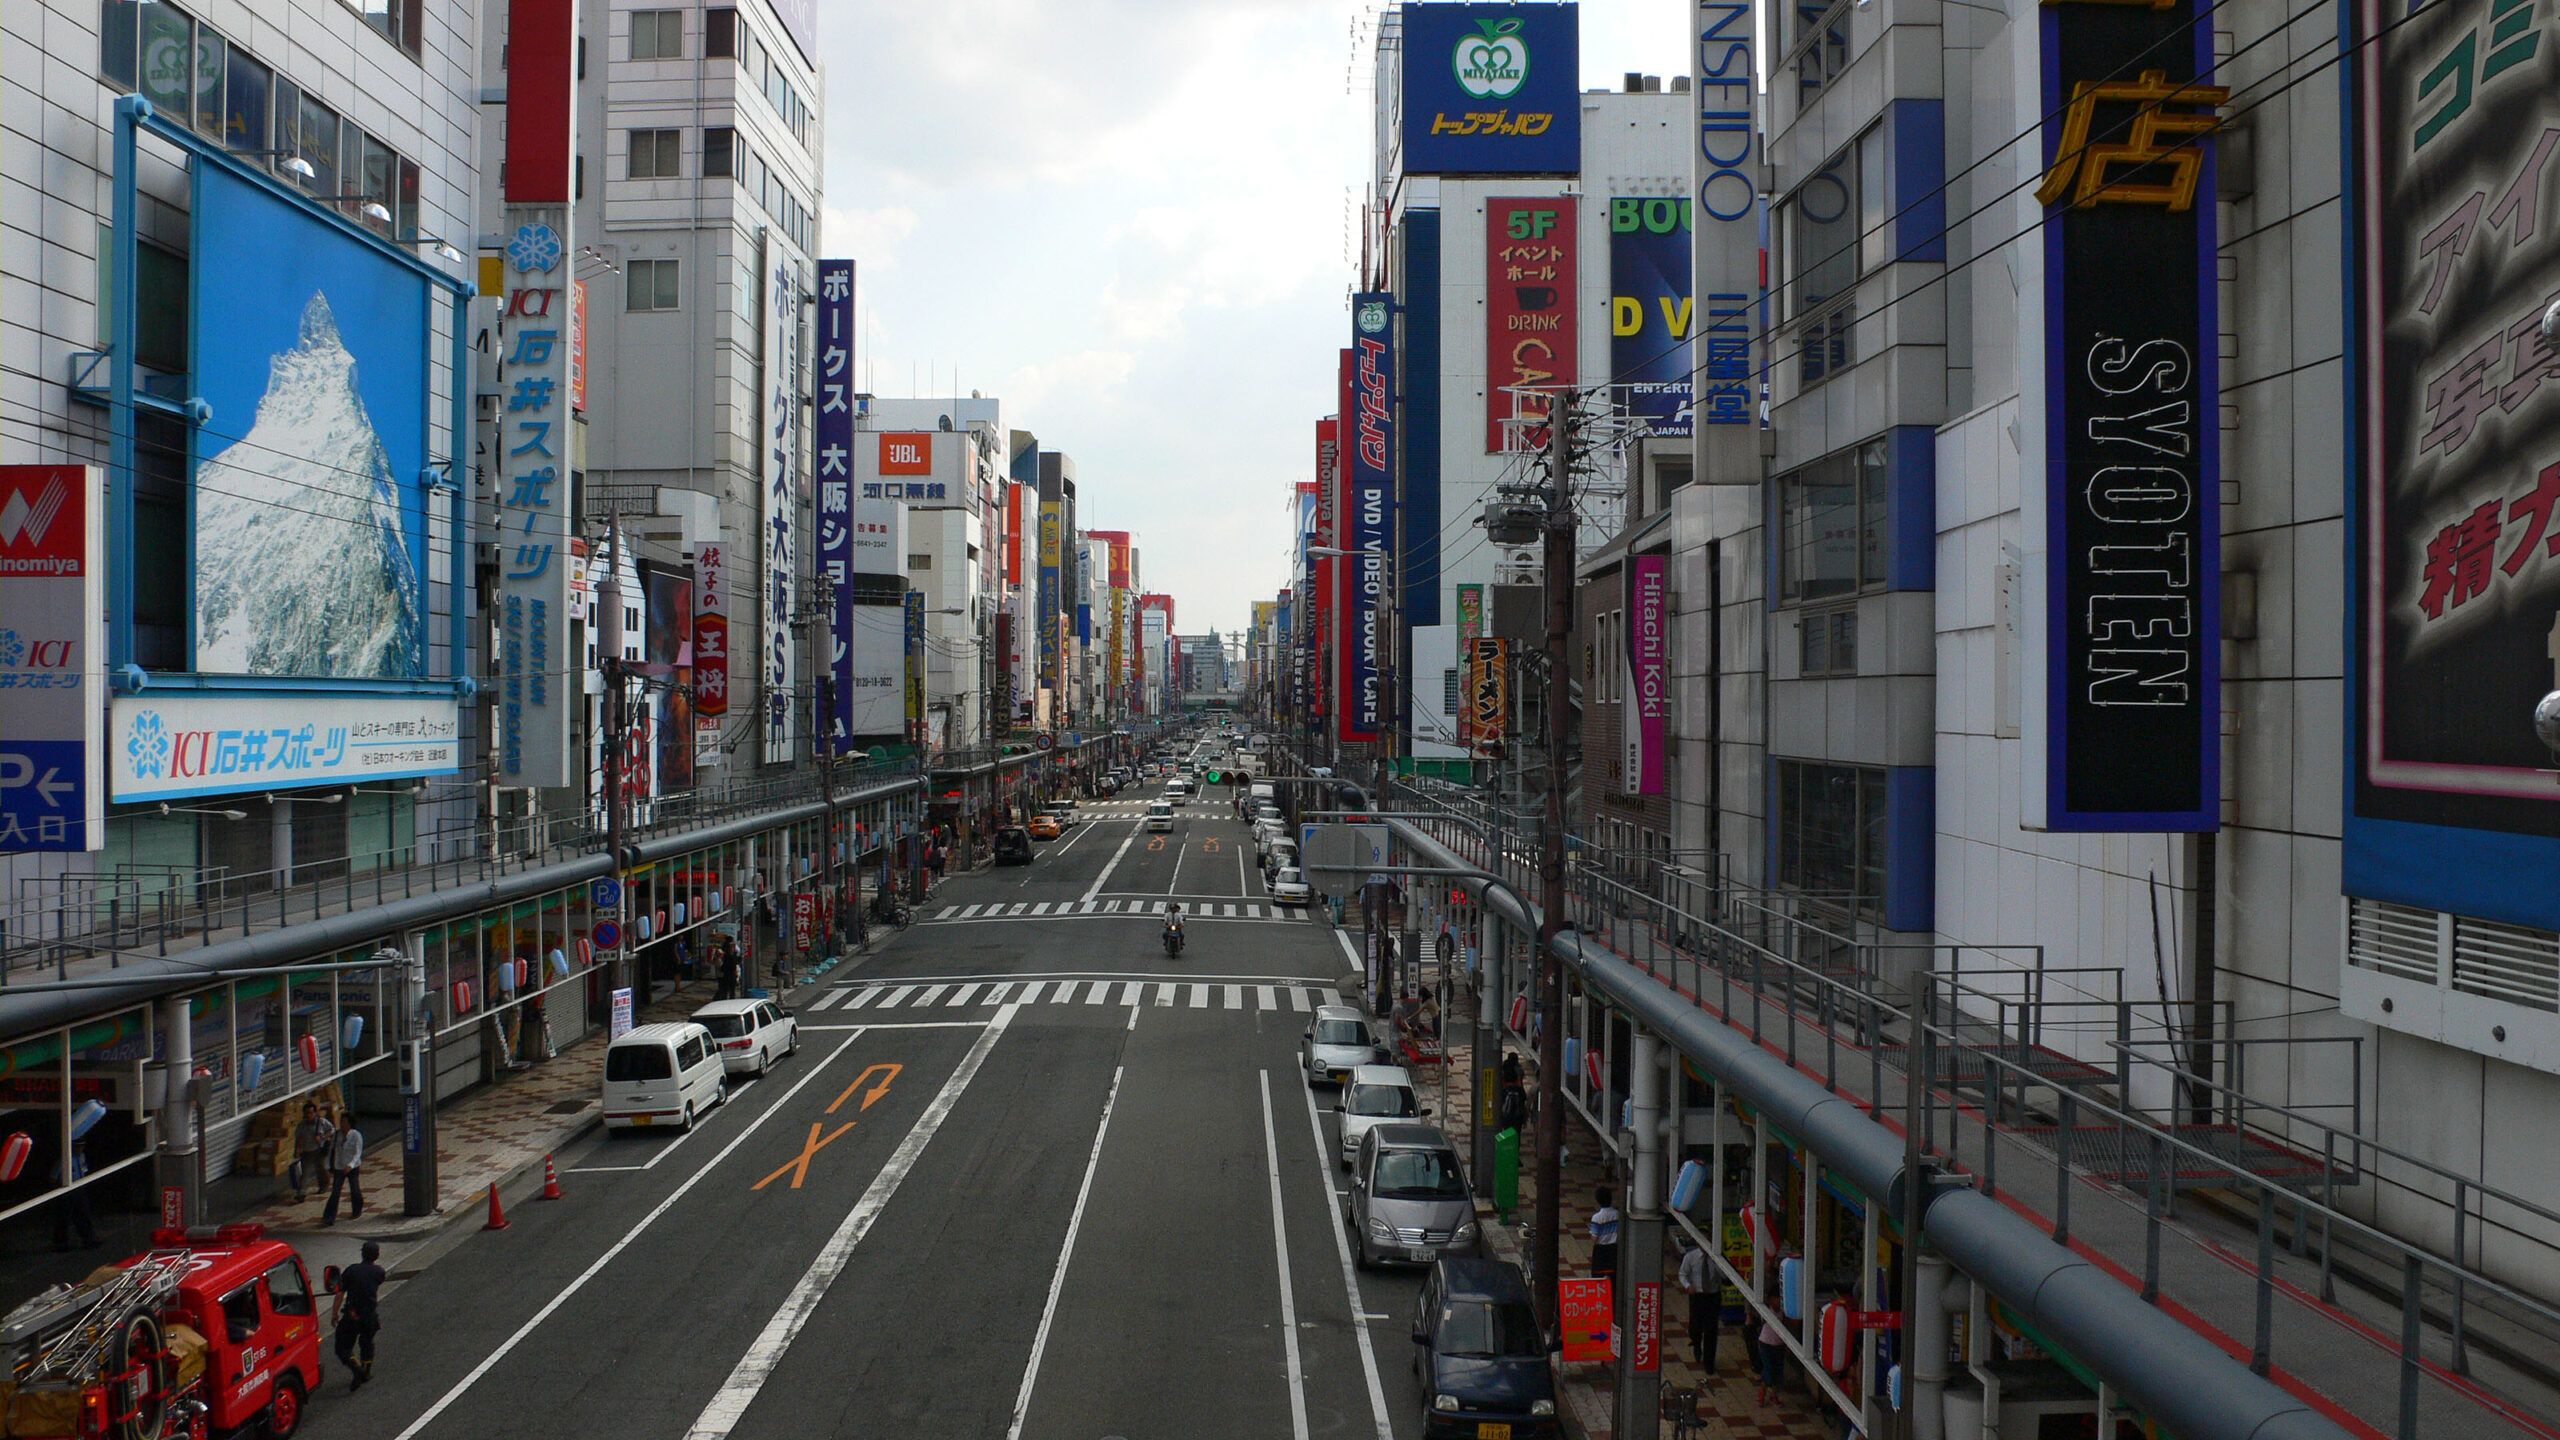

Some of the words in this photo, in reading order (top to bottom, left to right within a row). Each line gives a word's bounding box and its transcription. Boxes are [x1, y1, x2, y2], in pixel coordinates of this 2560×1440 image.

[1463, 68, 1520, 83] MIYATAKE
[1430, 109, 1554, 136] トップジャパン
[1507, 210, 1556, 240] 5F
[1499, 245, 1563, 262] イベント
[1507, 265, 1557, 282] ホール
[506, 288, 556, 318] ICI
[1508, 314, 1562, 331] DRINK
[822, 269, 849, 415] ボークス
[1359, 336, 1391, 472] トップジャパン
[506, 330, 560, 580] 石井スポーツ
[890, 444, 921, 463] JBL
[863, 482, 945, 499] 河口無線
[1321, 440, 1335, 521] Ninomiya
[1364, 488, 1381, 525] DVD
[2087, 336, 2191, 705] SYOTEN
[699, 547, 721, 607] 餃子の
[1643, 573, 1660, 657] Hitachi
[28, 640, 76, 668] ICI
[530, 599, 545, 706] MOUNTAIN
[696, 630, 726, 699] 王将
[506, 640, 521, 701] SNOW
[1478, 640, 1501, 722] ラーメン
[1643, 665, 1660, 718] Koki
[352, 721, 416, 738] 山とスキーの専門店
[168, 731, 215, 778] ICI
[209, 723, 347, 774] 石井スポーツ
[0, 813, 66, 844] 入口
[598, 885, 609, 904] P
[294, 987, 371, 1003] Panaonic
[1565, 1283, 1606, 1298] レコード
